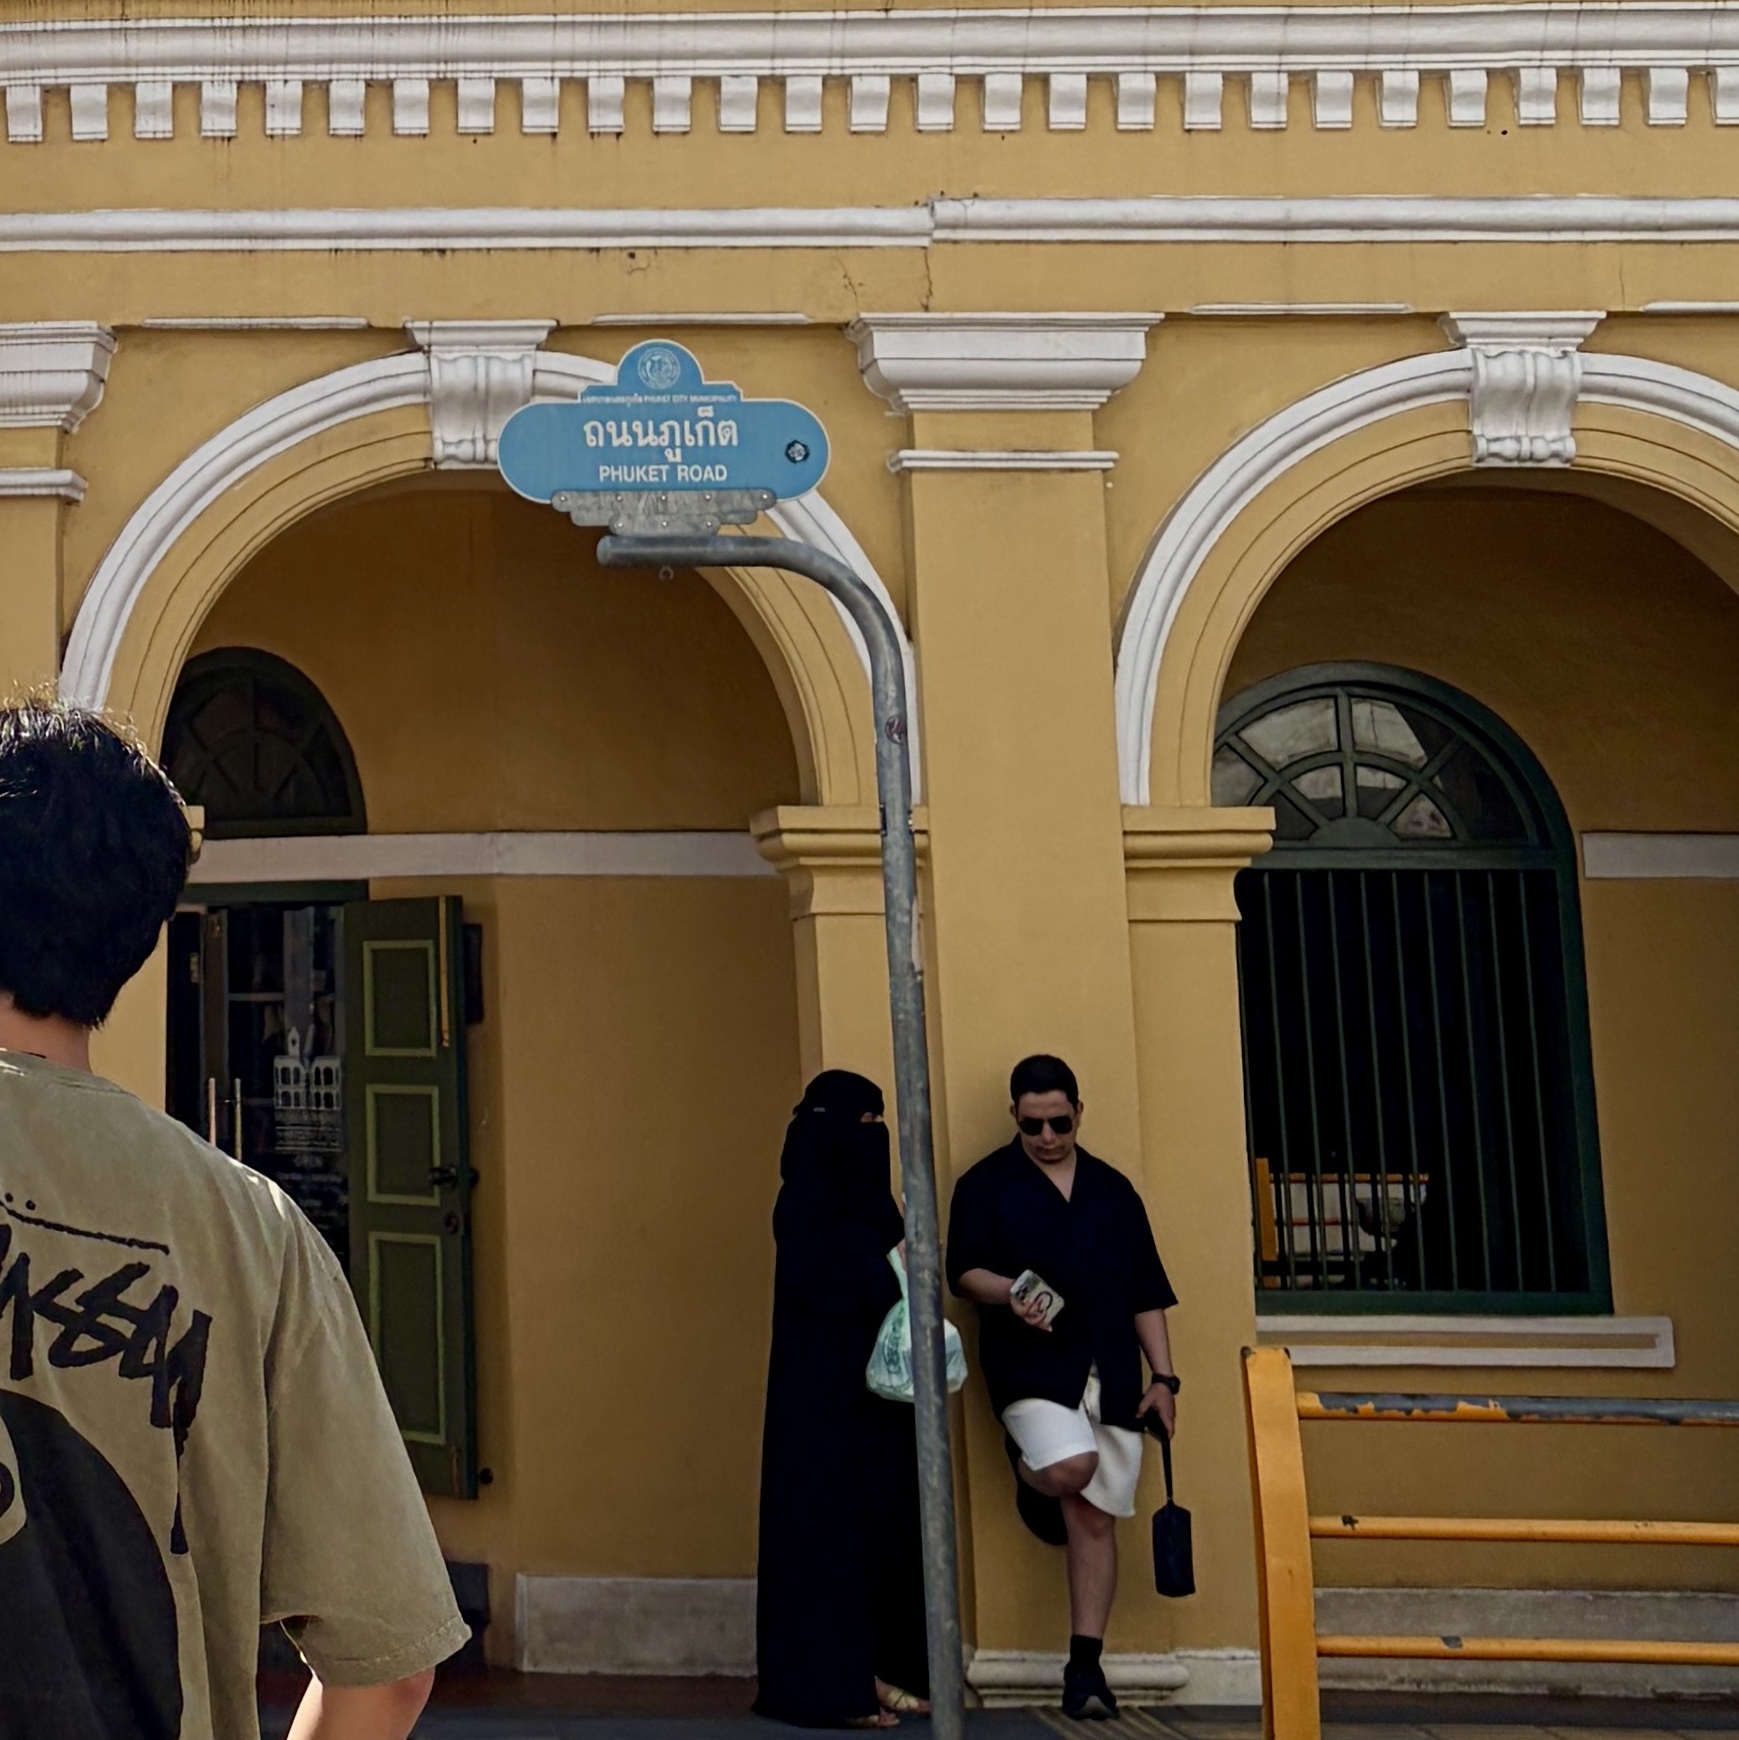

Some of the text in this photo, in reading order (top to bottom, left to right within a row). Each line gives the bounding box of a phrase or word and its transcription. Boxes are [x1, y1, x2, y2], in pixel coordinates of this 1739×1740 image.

[583, 406, 738, 463] ถนนภูเก็ต
[599, 465, 727, 482] PHUKET ROAD
